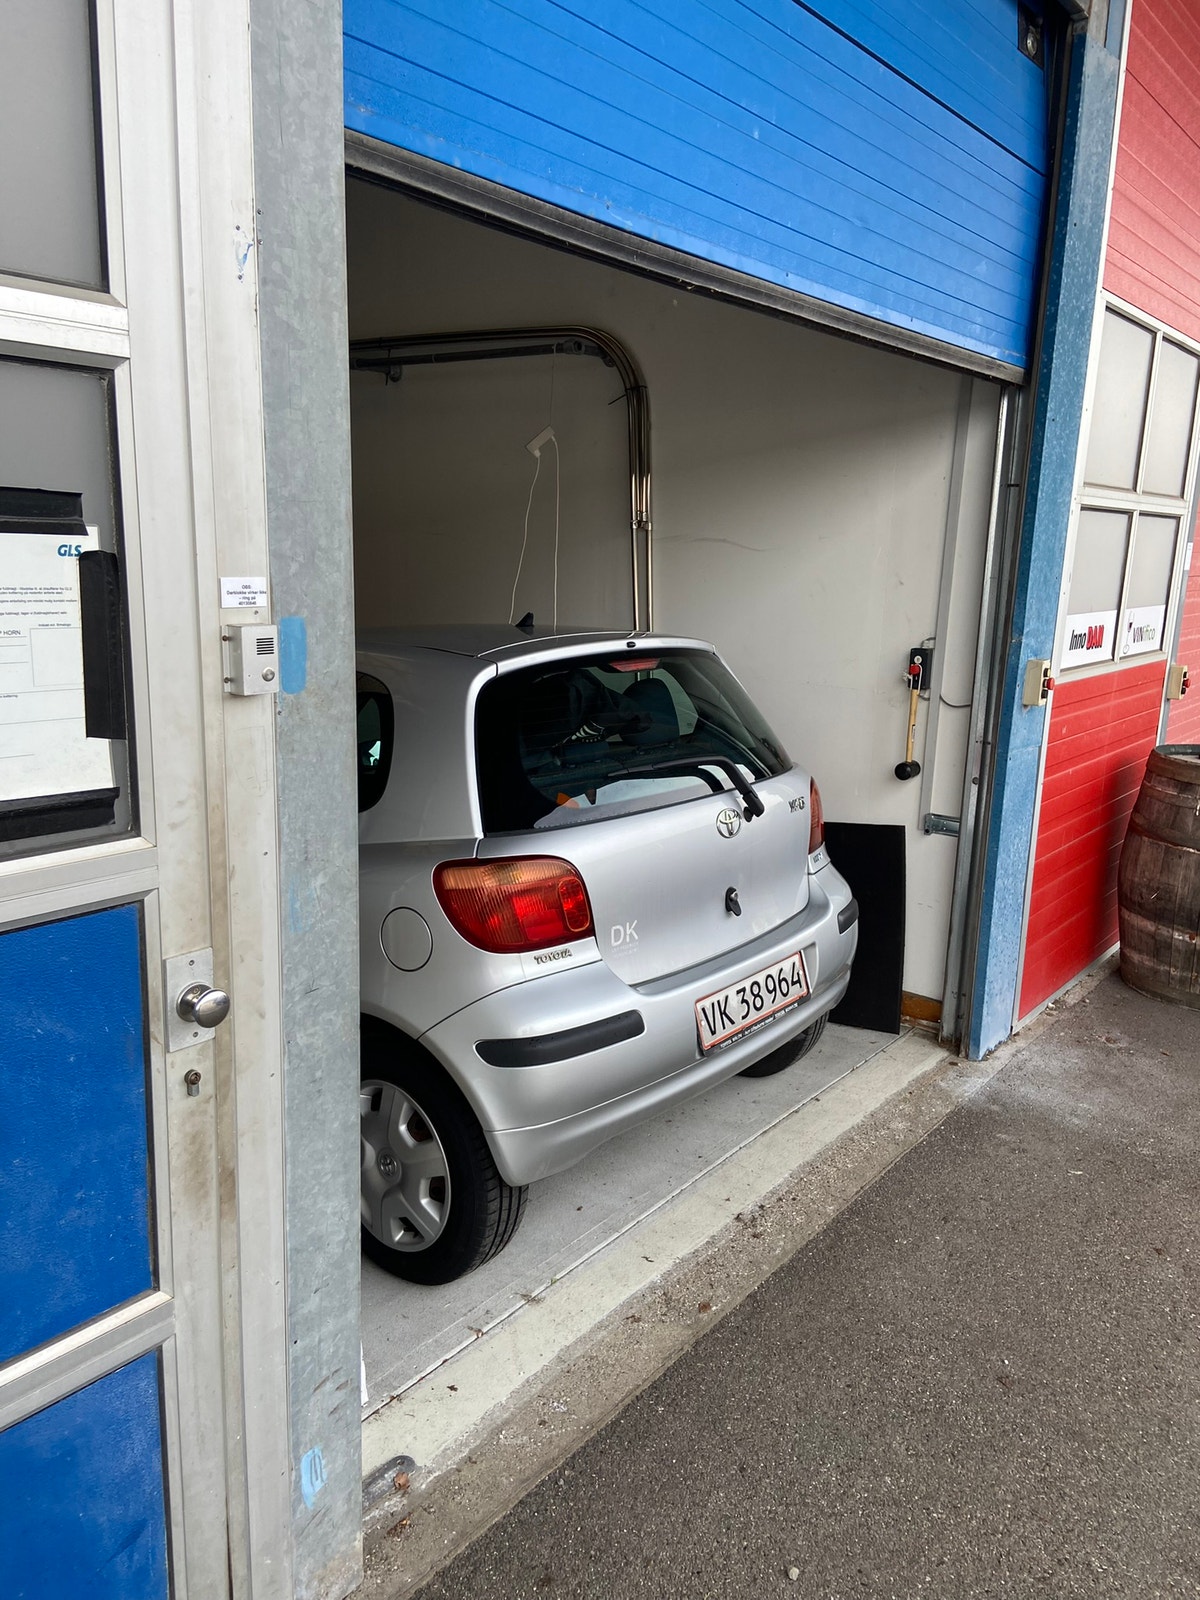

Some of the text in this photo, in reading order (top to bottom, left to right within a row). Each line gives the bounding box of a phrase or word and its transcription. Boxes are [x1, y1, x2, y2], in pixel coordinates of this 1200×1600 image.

[57, 544, 82, 557] GLS
[610, 919, 639, 947] DK
[533, 948, 573, 965] TOYOTA
[701, 994, 735, 1036] VK
